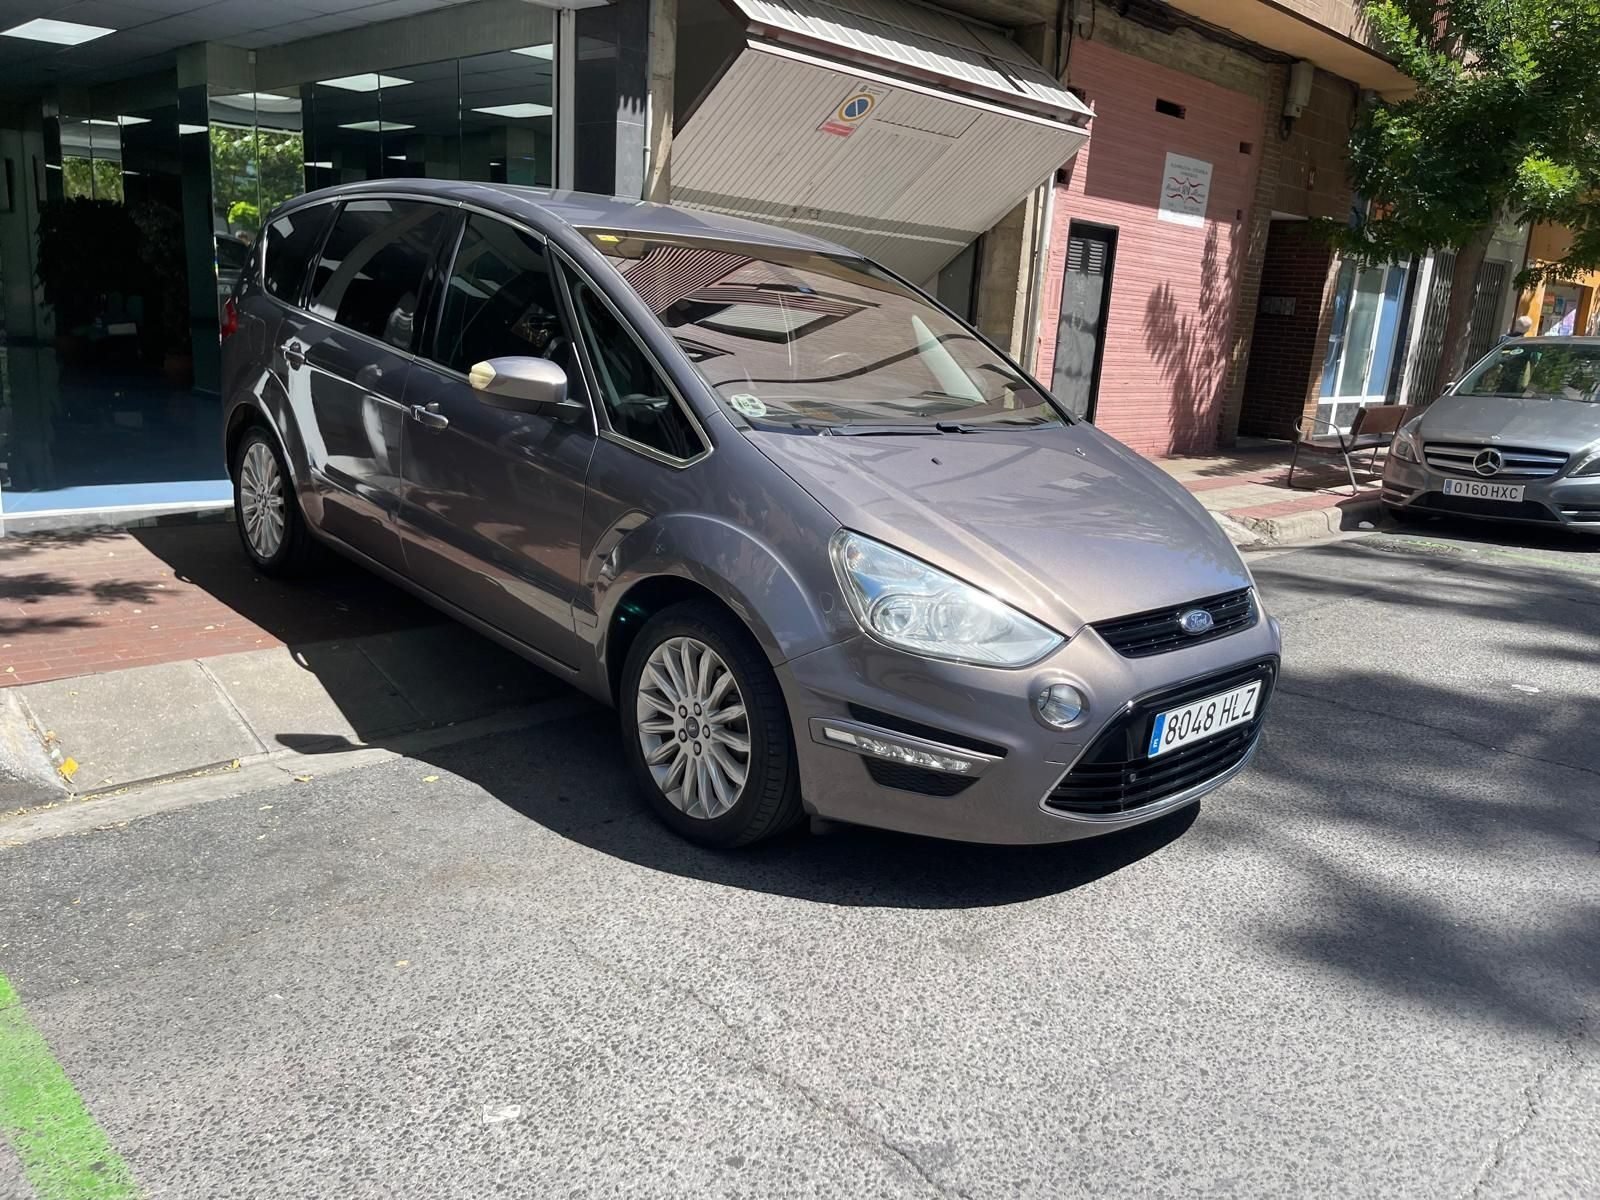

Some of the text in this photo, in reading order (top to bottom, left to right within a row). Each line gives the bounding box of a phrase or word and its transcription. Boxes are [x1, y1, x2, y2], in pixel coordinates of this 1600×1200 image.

[1454, 482, 1518, 500] 0160 HXC
[1190, 613, 1208, 626] Ford
[1165, 687, 1257, 745] 8048 HLZ
